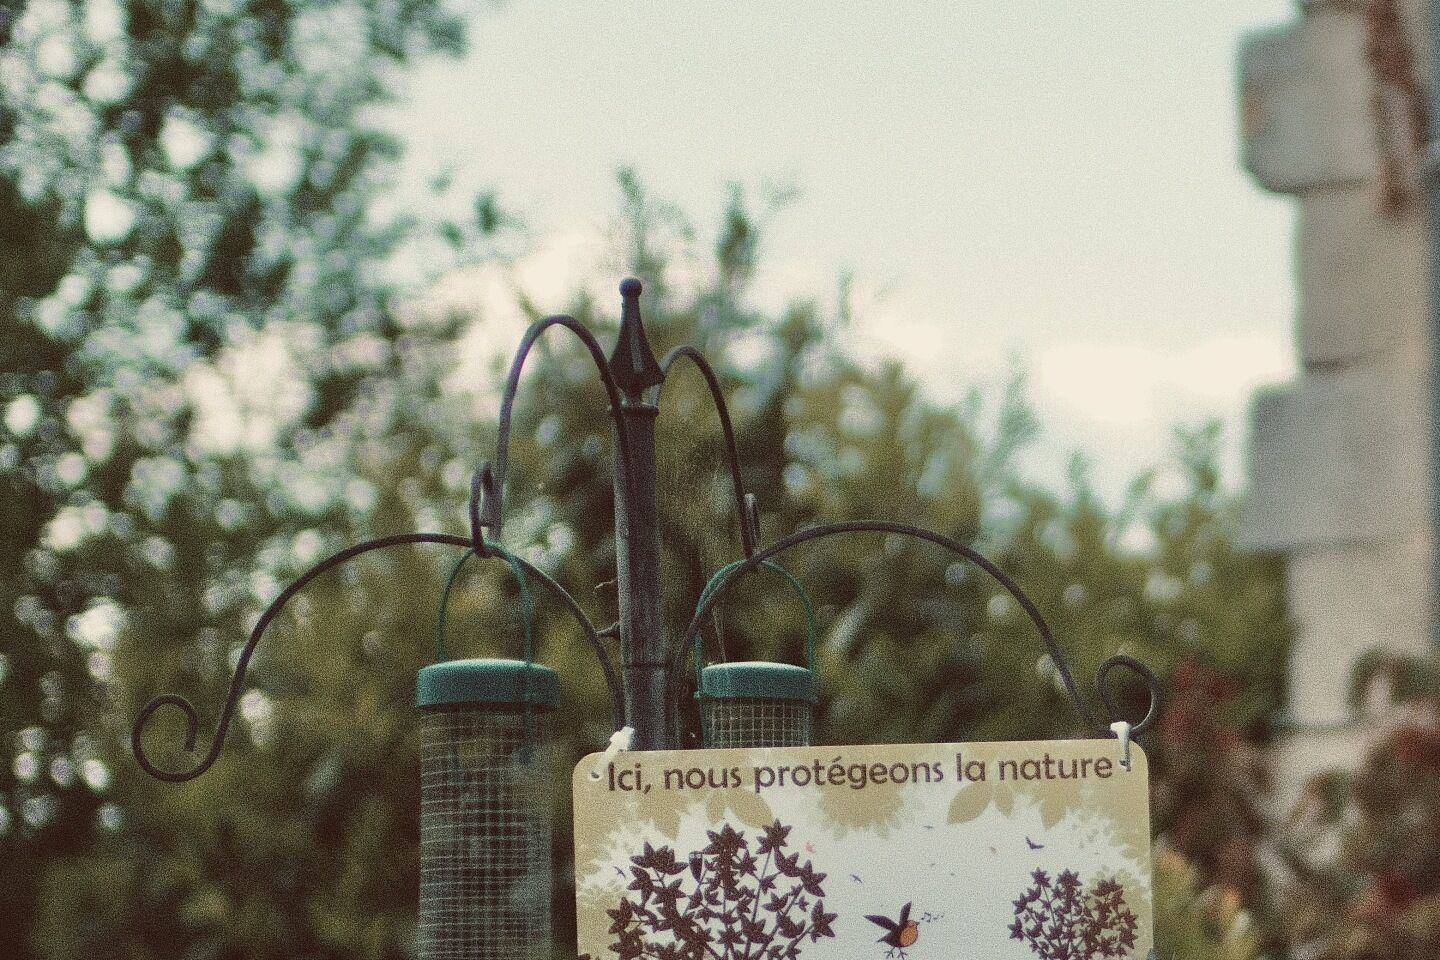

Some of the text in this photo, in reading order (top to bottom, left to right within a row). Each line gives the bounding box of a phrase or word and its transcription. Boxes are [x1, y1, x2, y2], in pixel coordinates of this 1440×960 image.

[608, 753, 1113, 794] Ici, nous protégeons la nature
